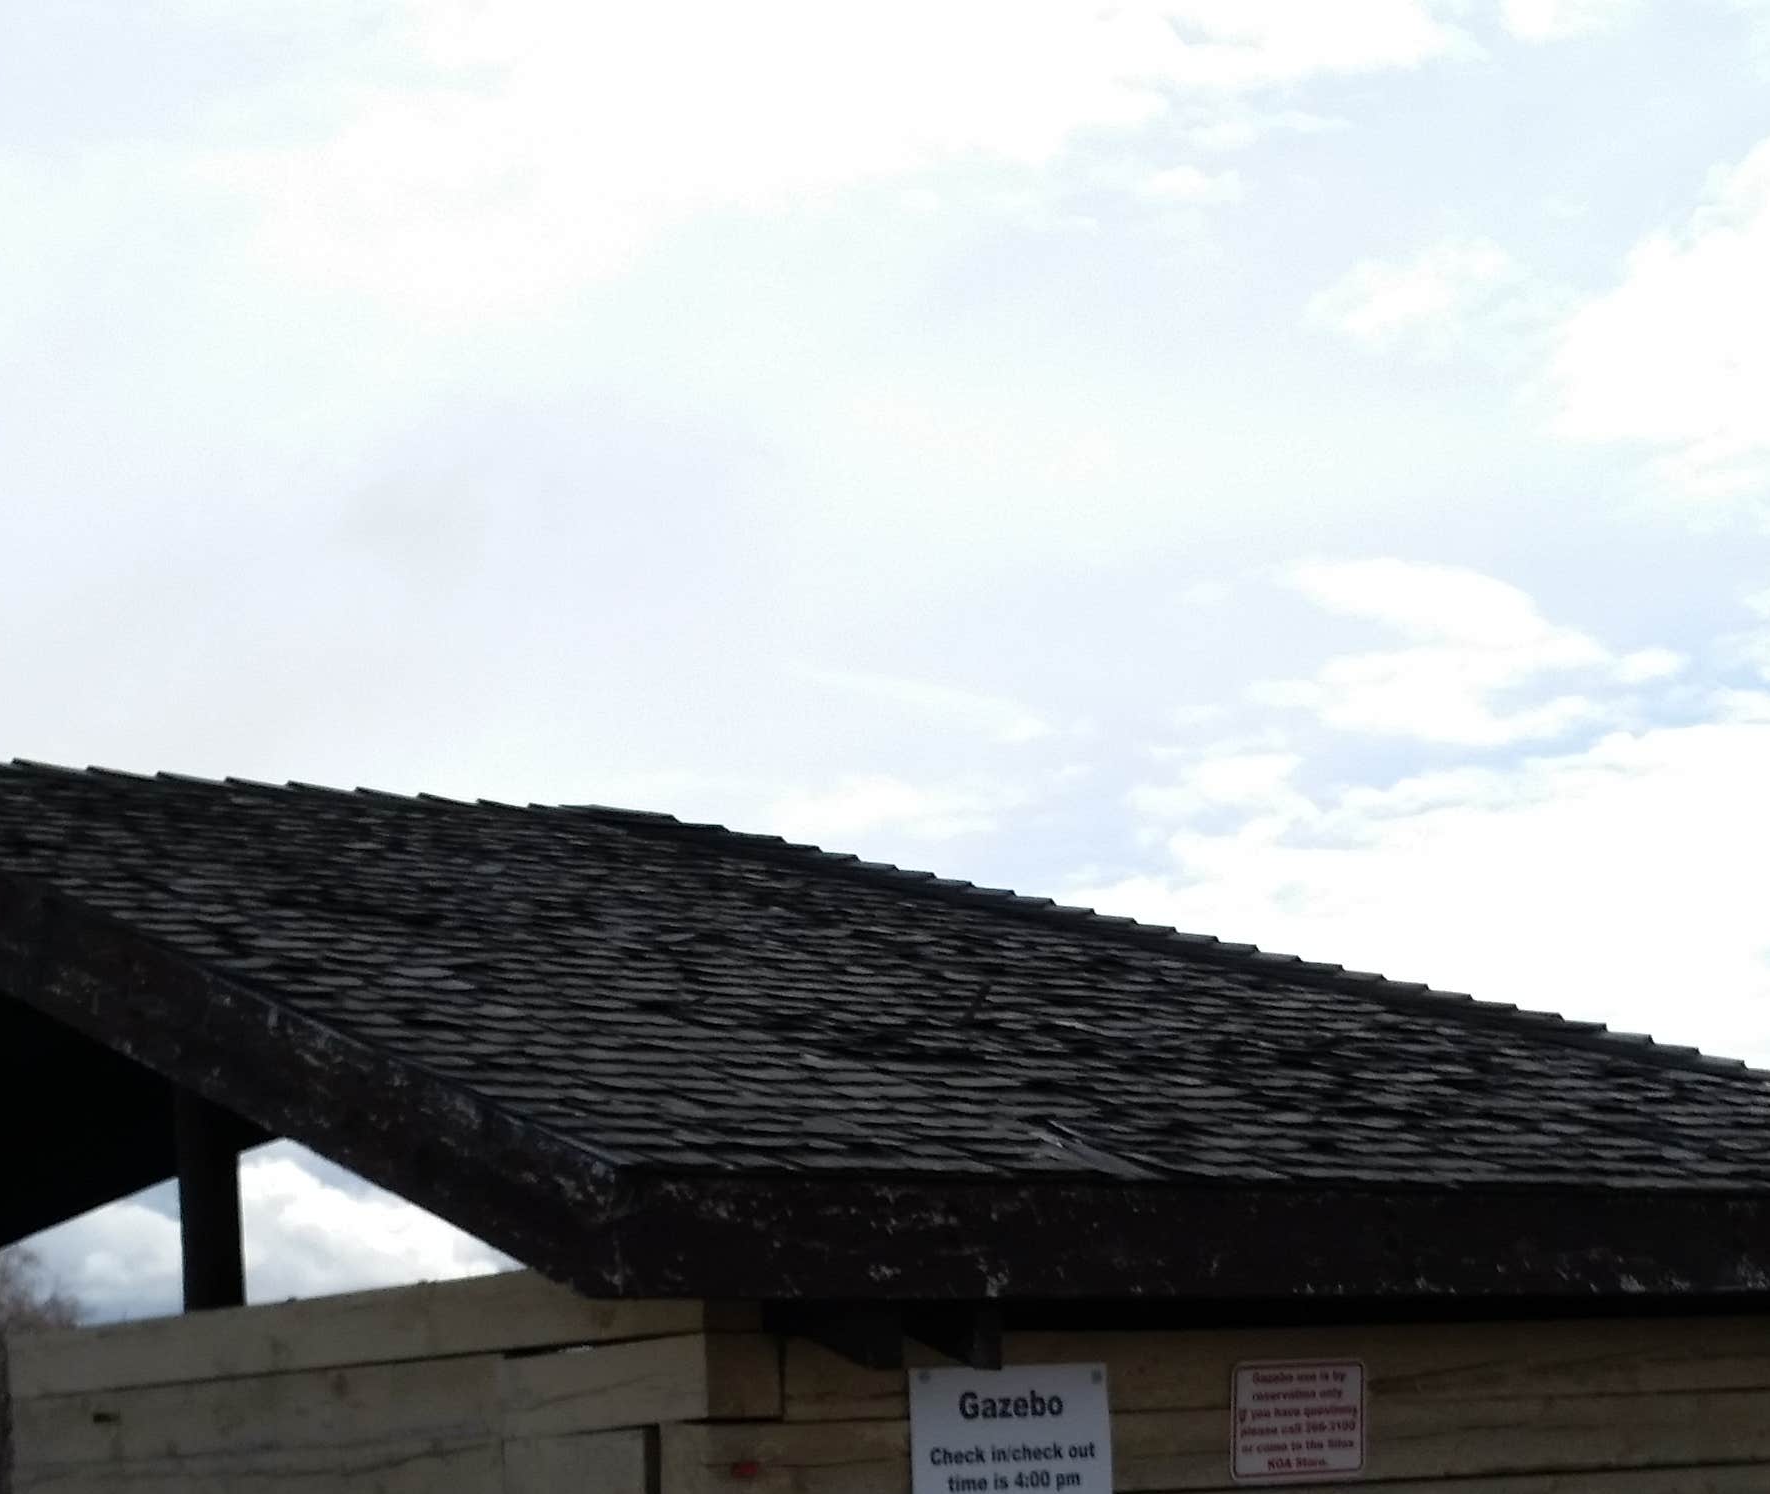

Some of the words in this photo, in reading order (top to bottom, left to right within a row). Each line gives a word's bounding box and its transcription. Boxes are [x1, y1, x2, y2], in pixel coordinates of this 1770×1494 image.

[959, 1390, 1063, 1420] Gazebo
[930, 1447, 985, 1466] Check
[1069, 1442, 1095, 1458] out
[948, 1476, 987, 1493] time
[994, 1474, 1008, 1490] is
[1014, 1471, 1050, 1488] 4:00
[1056, 1472, 1080, 1491] pm
